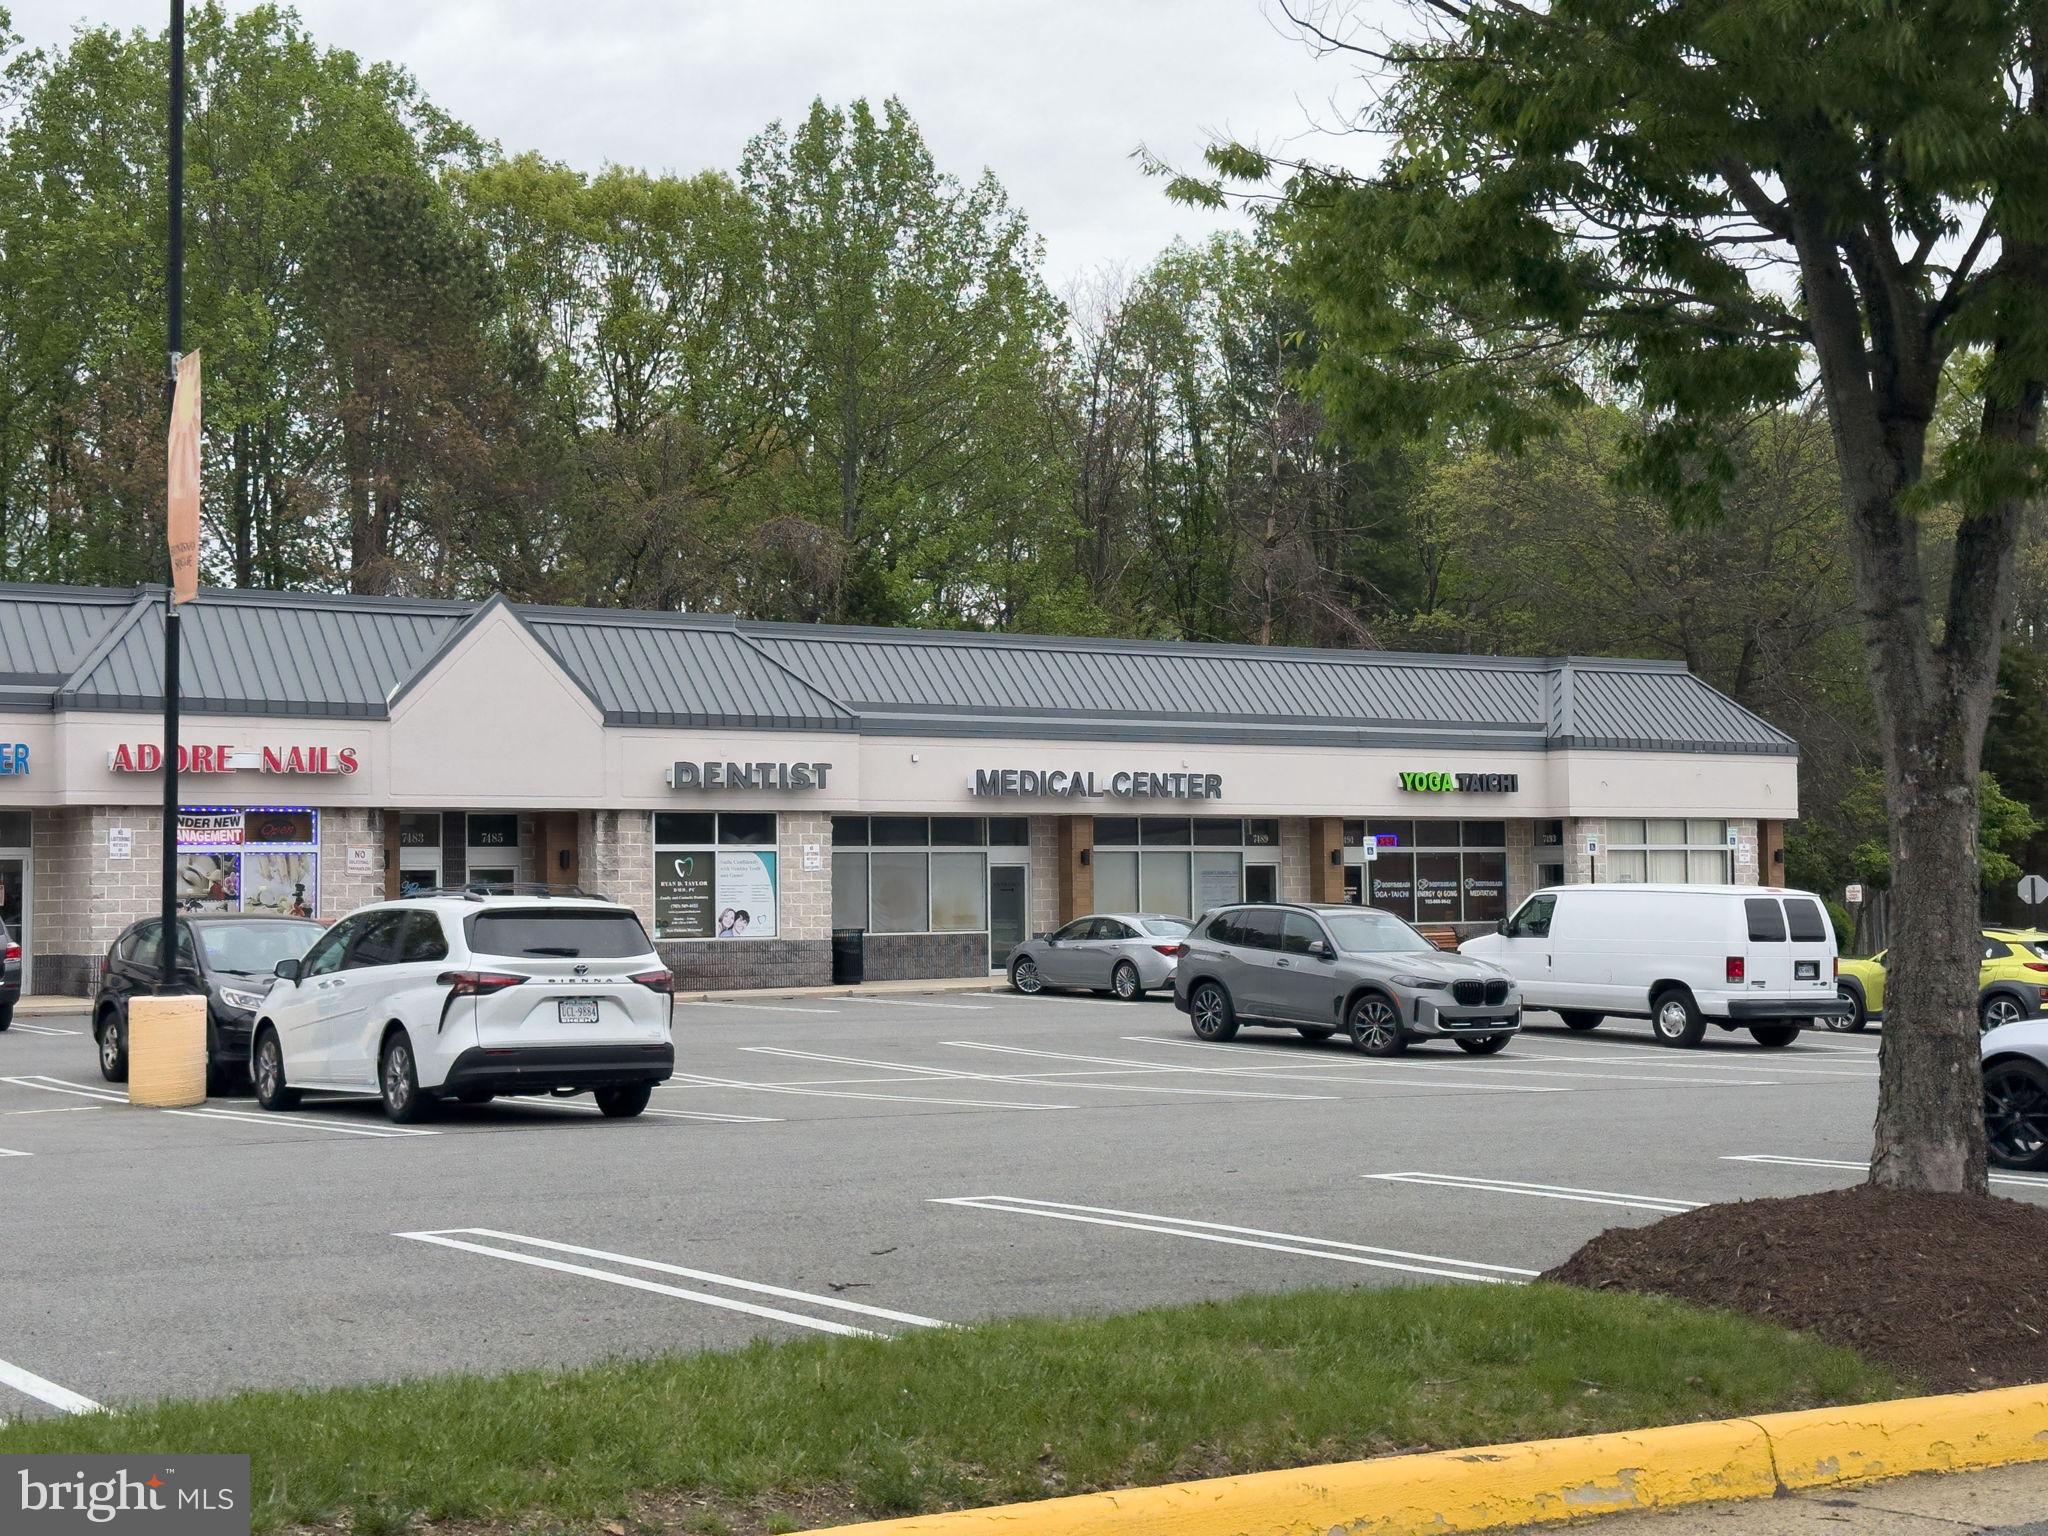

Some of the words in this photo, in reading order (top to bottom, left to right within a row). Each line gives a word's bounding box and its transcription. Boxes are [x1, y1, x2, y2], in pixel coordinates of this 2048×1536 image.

[262, 746, 360, 776] NAILS
[672, 761, 833, 790] DENTIST
[974, 769, 1104, 798] MEDICAL
[1110, 771, 1223, 799] CENTER
[1399, 771, 1454, 792] YOGA
[1455, 773, 1519, 793] TAICHI
[177, 817, 210, 828] NDER
[213, 816, 242, 828] NEW
[177, 829, 242, 842] ANAGEMENT
[354, 850, 366, 859] NO
